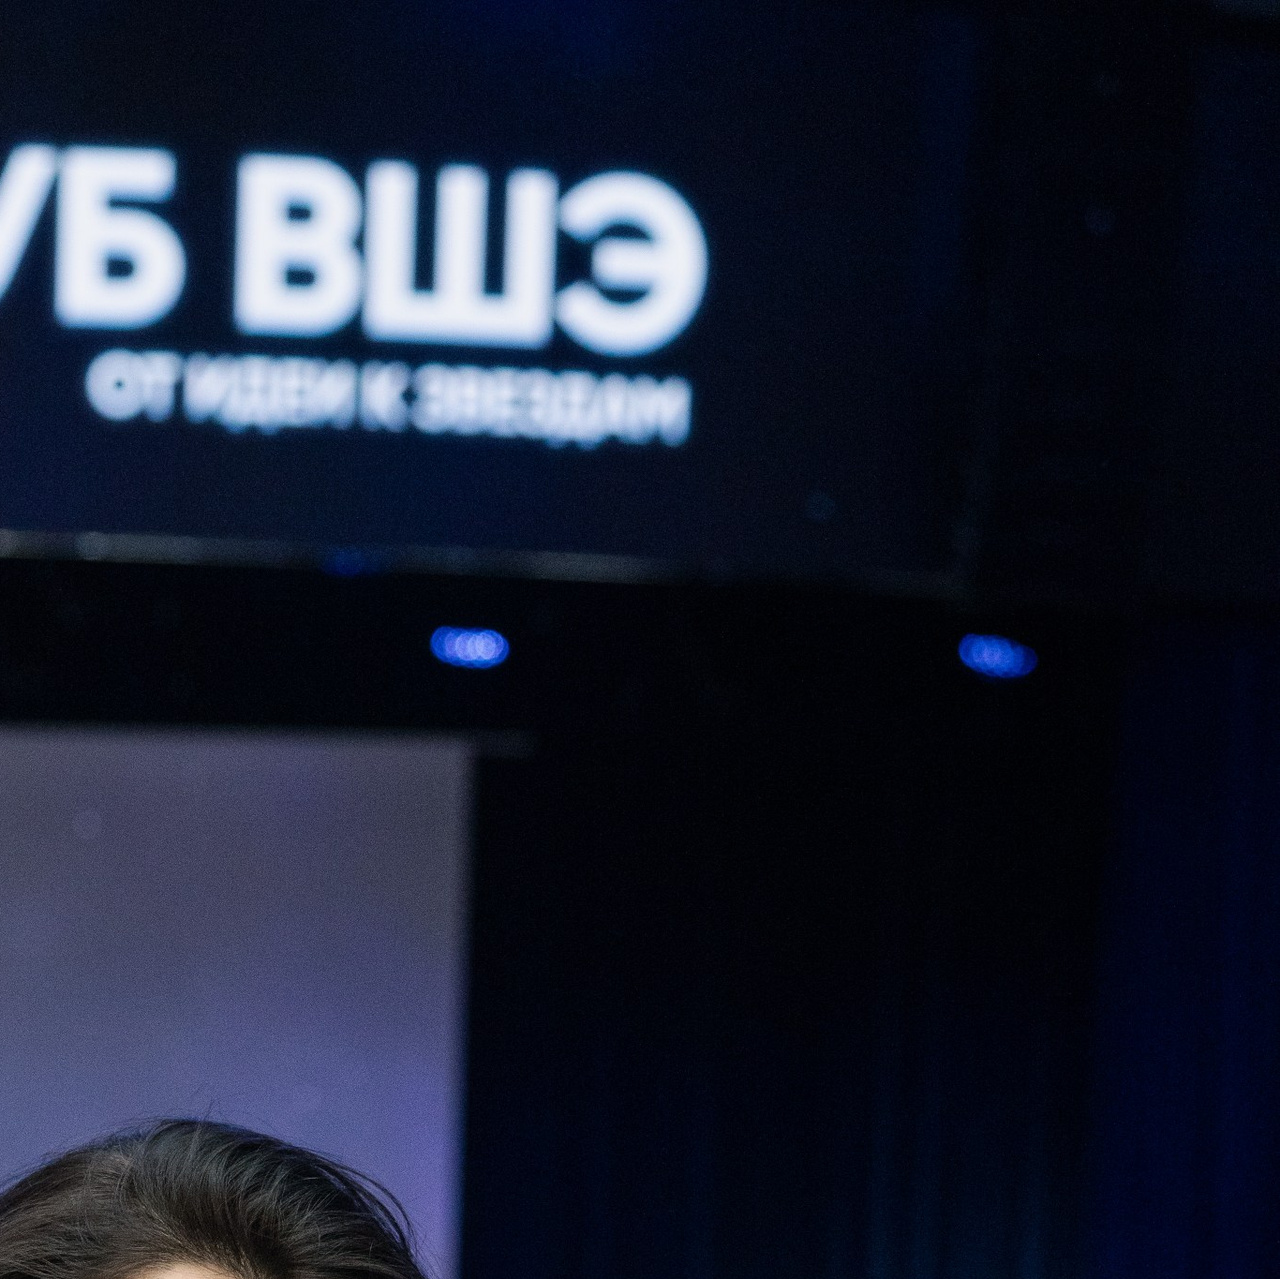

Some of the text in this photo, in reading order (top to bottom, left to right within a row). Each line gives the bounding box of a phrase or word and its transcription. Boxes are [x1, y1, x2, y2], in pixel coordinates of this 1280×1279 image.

[233, 153, 707, 357] ВШЭ
[86, 350, 178, 420] ОТ
[360, 361, 410, 430] К
